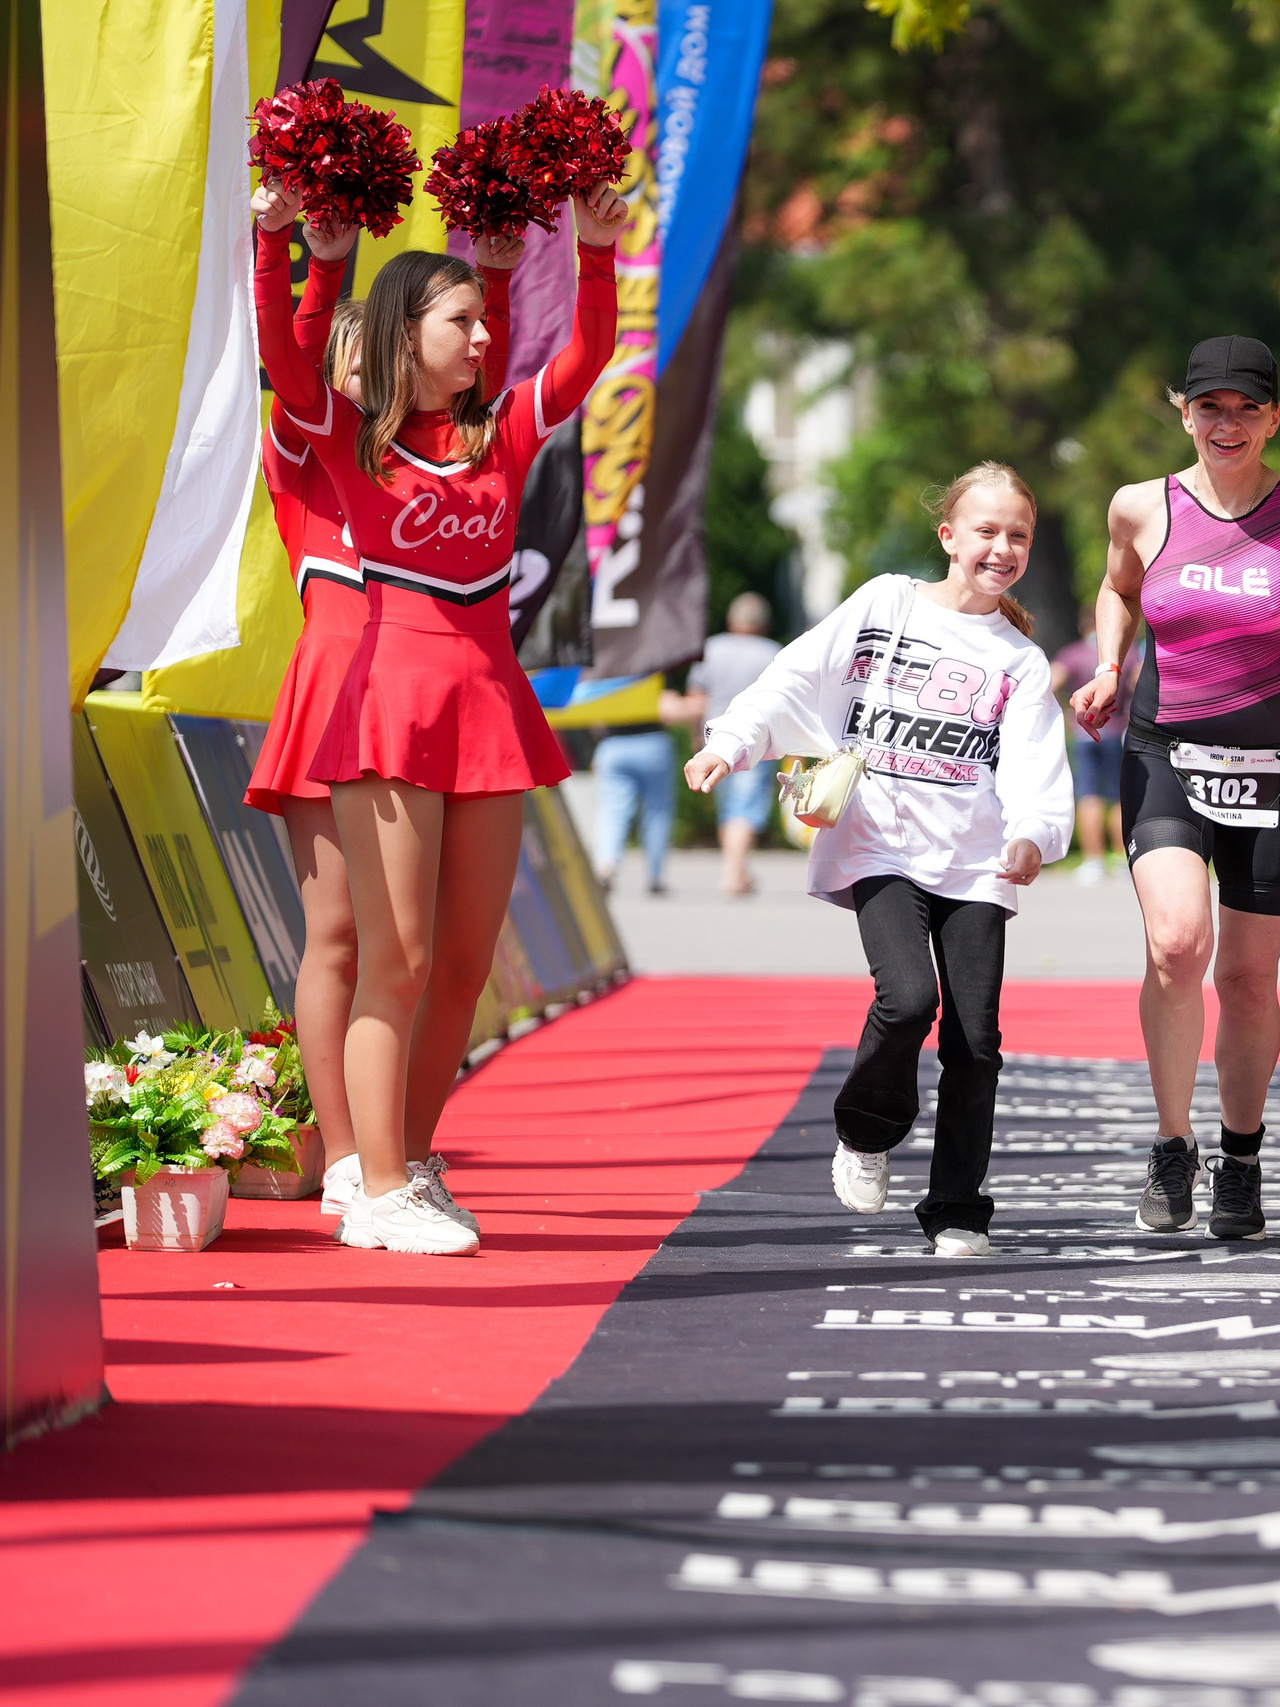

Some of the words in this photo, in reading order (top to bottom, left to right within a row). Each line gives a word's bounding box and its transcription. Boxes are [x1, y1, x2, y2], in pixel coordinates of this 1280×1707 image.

[391, 492, 506, 549] Cool
[1209, 752, 1225, 761] IRON
[1230, 755, 1245, 763] STAR
[935, 760, 979, 782] GIRL
[1190, 775, 1258, 805] 3102
[1208, 809, 1243, 820] VALENTINA
[821, 1308, 1147, 1328] IRON
[779, 1396, 1155, 1411] IRON
[715, 1491, 1166, 1526] IRON
[679, 1552, 1176, 1600] IRON
